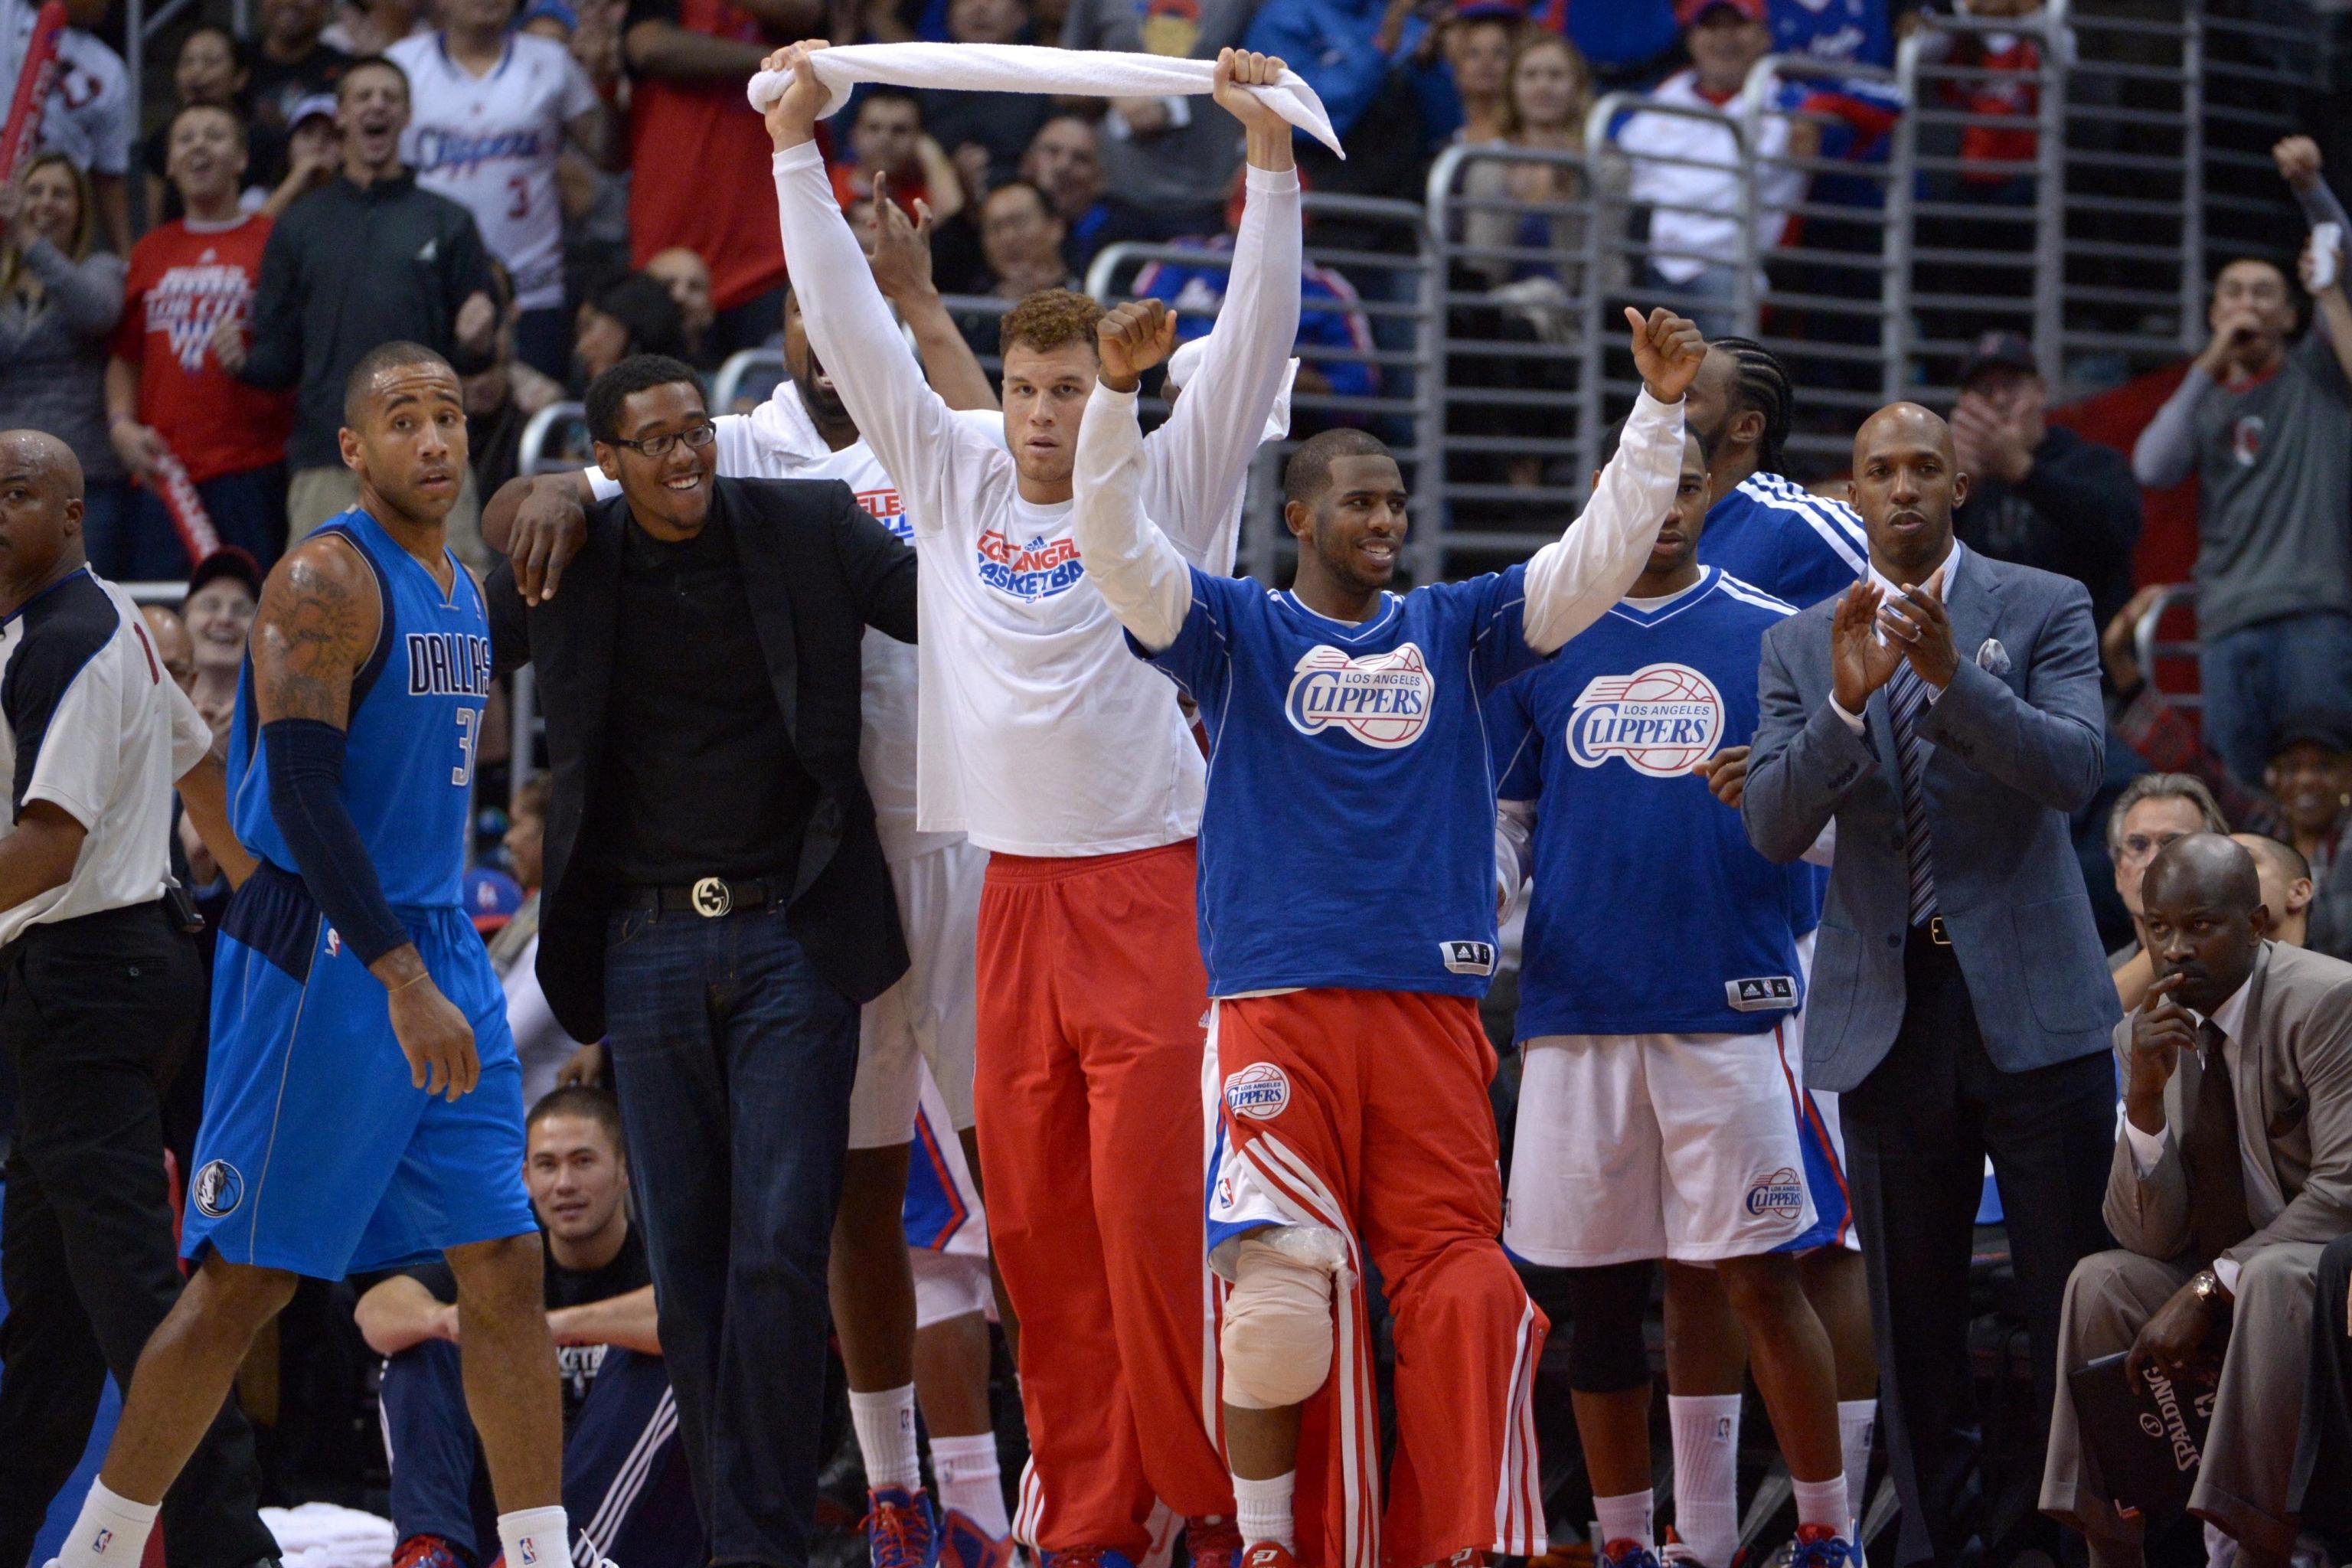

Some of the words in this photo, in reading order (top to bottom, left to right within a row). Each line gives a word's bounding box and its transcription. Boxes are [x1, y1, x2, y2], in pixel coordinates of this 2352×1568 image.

[406, 633, 491, 697] DALLAS
[1345, 674, 1370, 684] LOS
[1373, 675, 1421, 687] ANGELES
[1292, 671, 1422, 730] CLIPPERS
[1624, 705, 1648, 715] LOS
[1651, 706, 1710, 715] ANGELES
[1573, 704, 1707, 762] CLIPPERS
[1746, 1186, 1801, 1216] CLIPPERS
[2142, 1367, 2202, 1472] SPALDING
